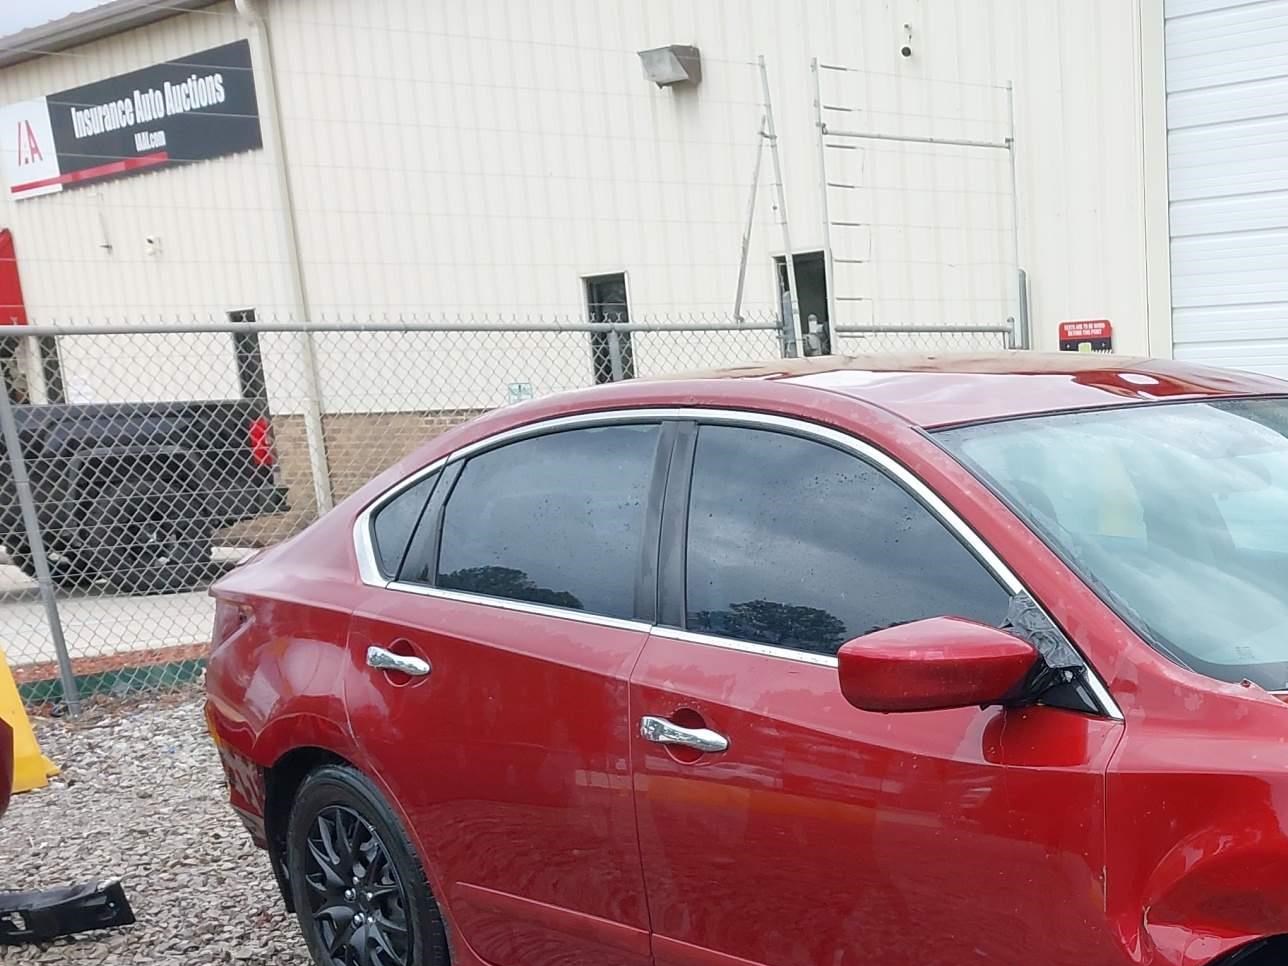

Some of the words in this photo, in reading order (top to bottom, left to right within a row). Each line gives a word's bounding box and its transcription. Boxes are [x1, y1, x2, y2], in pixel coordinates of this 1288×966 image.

[71, 96, 135, 139] Insurance
[133, 88, 164, 124] Auto
[163, 73, 226, 116] Auctions
